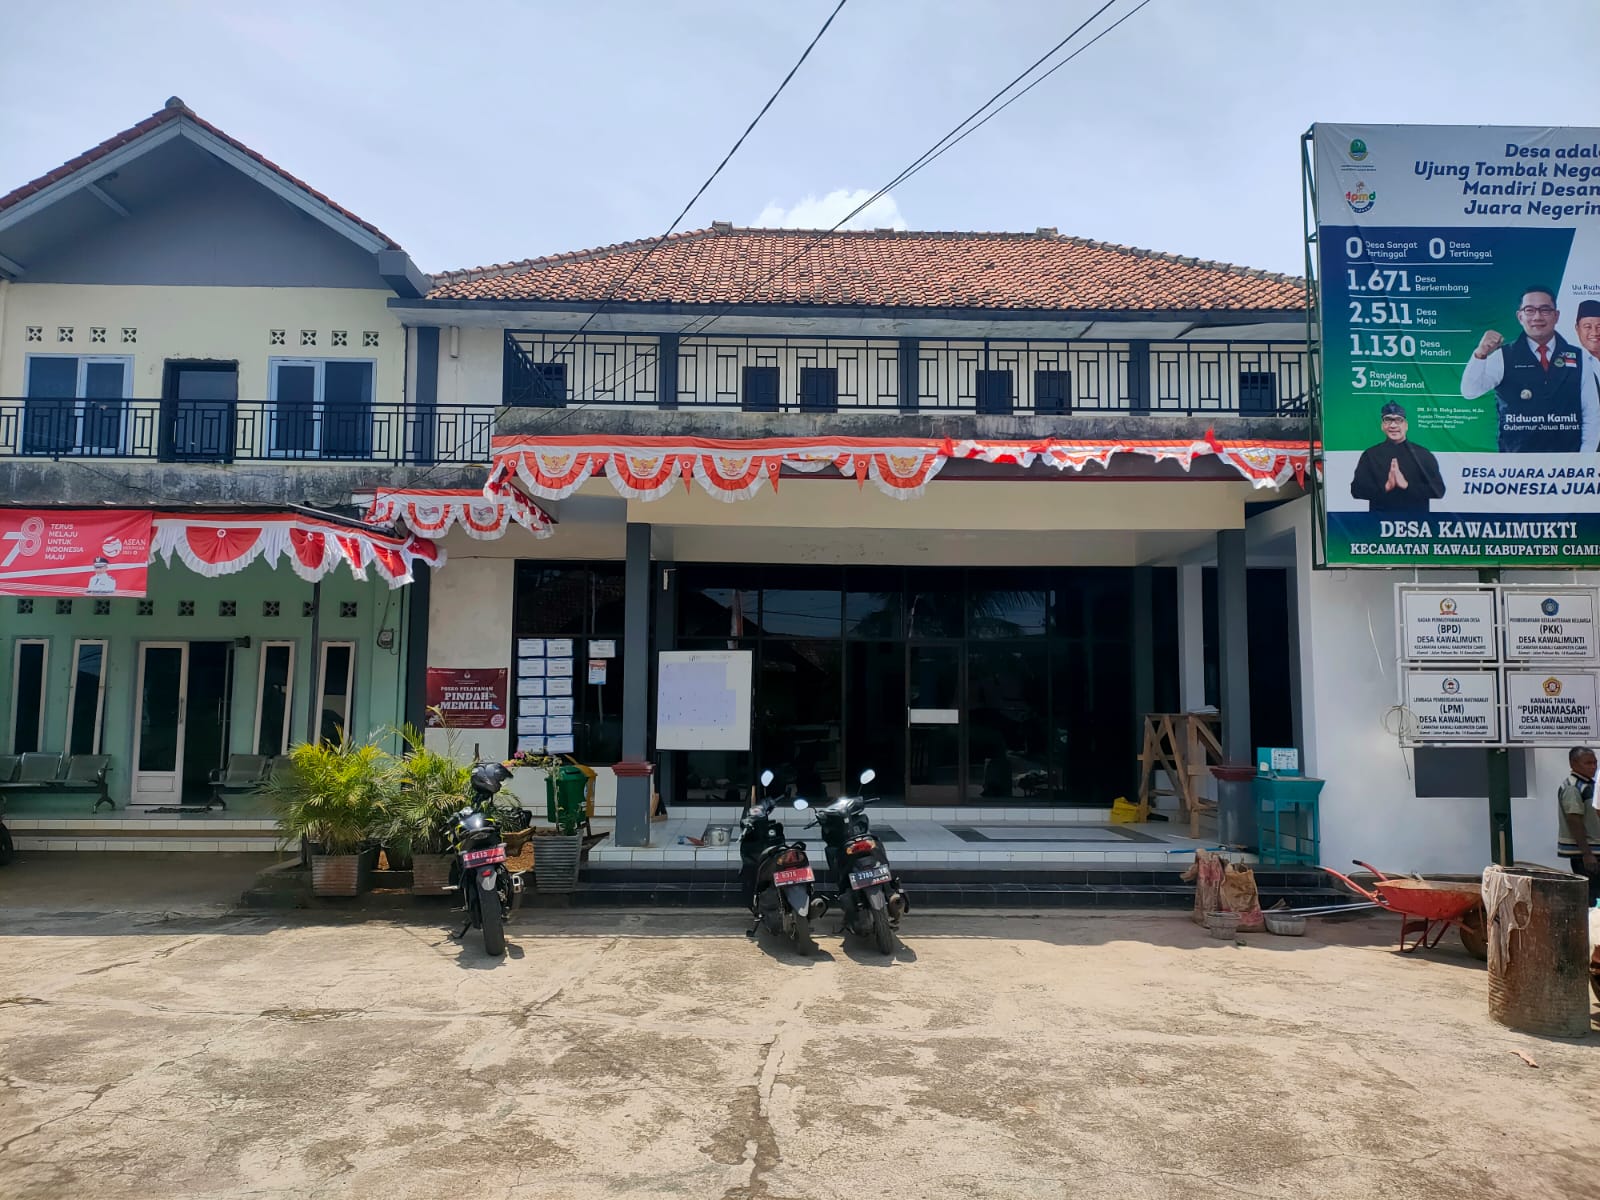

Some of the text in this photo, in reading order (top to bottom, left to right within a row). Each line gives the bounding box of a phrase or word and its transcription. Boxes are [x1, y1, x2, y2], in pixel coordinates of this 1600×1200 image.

[1505, 143, 1600, 158] Desa adal
[1414, 161, 1470, 181] Ujung
[1475, 161, 1548, 177] Tombak
[1463, 180, 1537, 196] Mandiri
[1464, 199, 1522, 215] Juara
[1345, 236, 1364, 259] 0
[1386, 241, 1418, 251] Sangat
[1428, 237, 1446, 260] 0
[1449, 241, 1471, 249] Desa
[1450, 250, 1493, 260] Tertinggal
[1347, 269, 1411, 292] 1.671
[1415, 275, 1437, 283] Desa
[1415, 283, 1469, 293] Berkembang
[1349, 301, 1413, 324] 2.511
[1416, 308, 1437, 316] Desa
[1416, 316, 1437, 326] Maju
[1350, 334, 1416, 357] 1.130
[1420, 340, 1440, 348] Desa
[1420, 348, 1452, 357] Mandiri
[1351, 366, 1367, 388] 3
[1388, 380, 1425, 389] Nasional
[1505, 413, 1577, 423] Ridwan Kamil
[1503, 423, 1537, 431] Gubernur
[1559, 423, 1580, 431] Barat
[1461, 467, 1496, 478] DESA
[1498, 468, 1545, 478] JUARA
[1547, 467, 1595, 478] JABAR
[1463, 482, 1558, 495] INDONESIA
[1380, 520, 1578, 539] DESA KAWALIMUKTI
[1350, 543, 1600, 556] KECAMATAN KAWALI KABUPATEN CIAMI
[1437, 623, 1461, 635] (BPD)
[1540, 624, 1563, 635] (PKK)
[1417, 635, 1483, 644] DESA KAWALIMUKTI
[1518, 636, 1585, 644] DESA KAWALIMUKTI
[444, 692, 489, 701] PINDAH
[440, 701, 493, 710] MEMILIH
[1440, 703, 1464, 715] (LPM)
[1438, 716, 1486, 724] KAWALIMUKTI
[1540, 716, 1587, 724] KAWALIMUKTI
